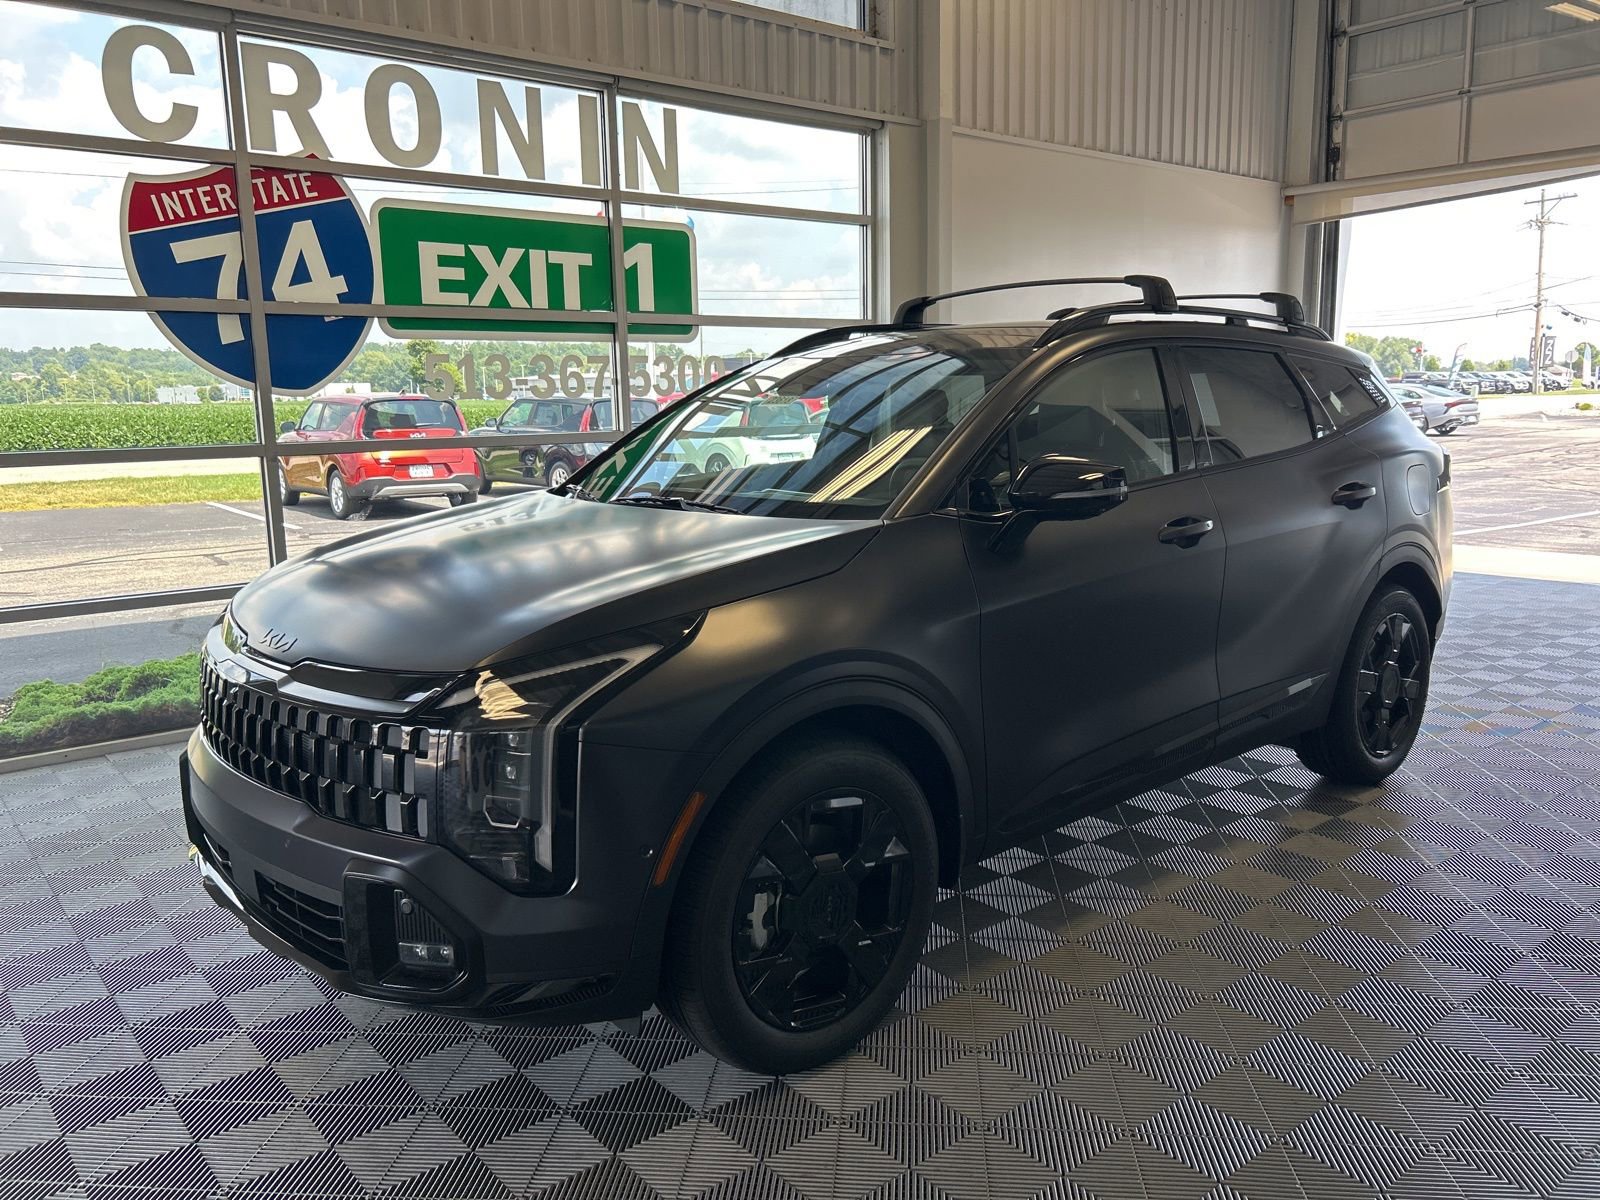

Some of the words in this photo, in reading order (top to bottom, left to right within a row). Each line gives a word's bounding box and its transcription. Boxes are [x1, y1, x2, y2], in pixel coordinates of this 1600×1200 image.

[102, 25, 680, 195] CRONIN
[151, 173, 319, 222] INTERTATE
[169, 219, 349, 345] 74
[417, 241, 593, 310] EXIT
[623, 243, 655, 312] 1
